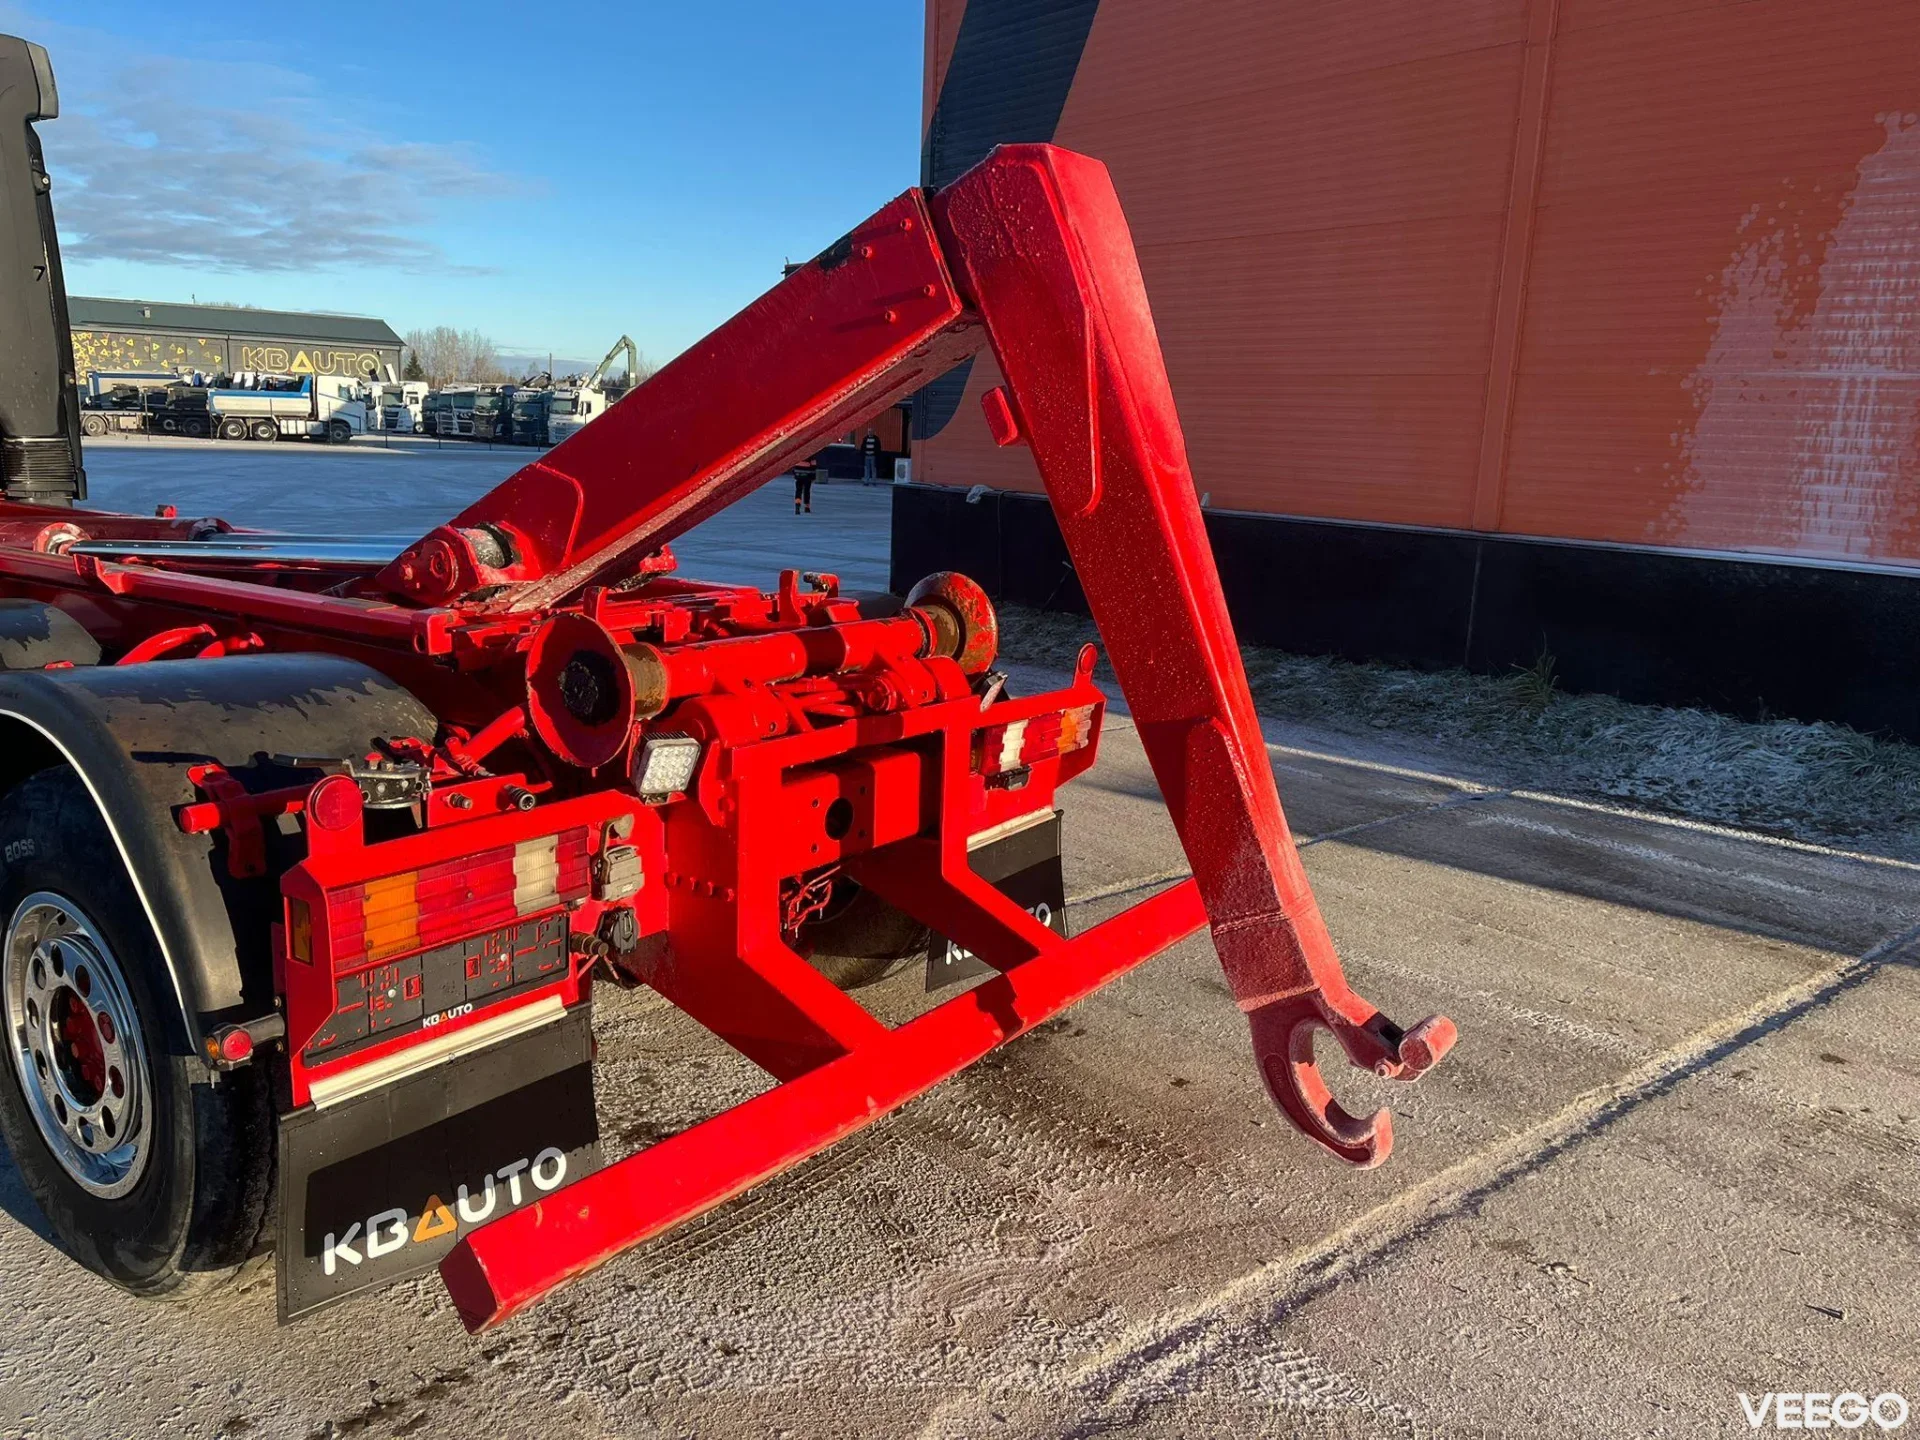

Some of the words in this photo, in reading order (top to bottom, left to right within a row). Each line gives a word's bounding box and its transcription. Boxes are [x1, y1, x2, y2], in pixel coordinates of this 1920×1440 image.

[242, 346, 381, 377] KBAUTO
[422, 1002, 473, 1028] KBAUTO
[324, 1147, 567, 1275] KBAUTO
